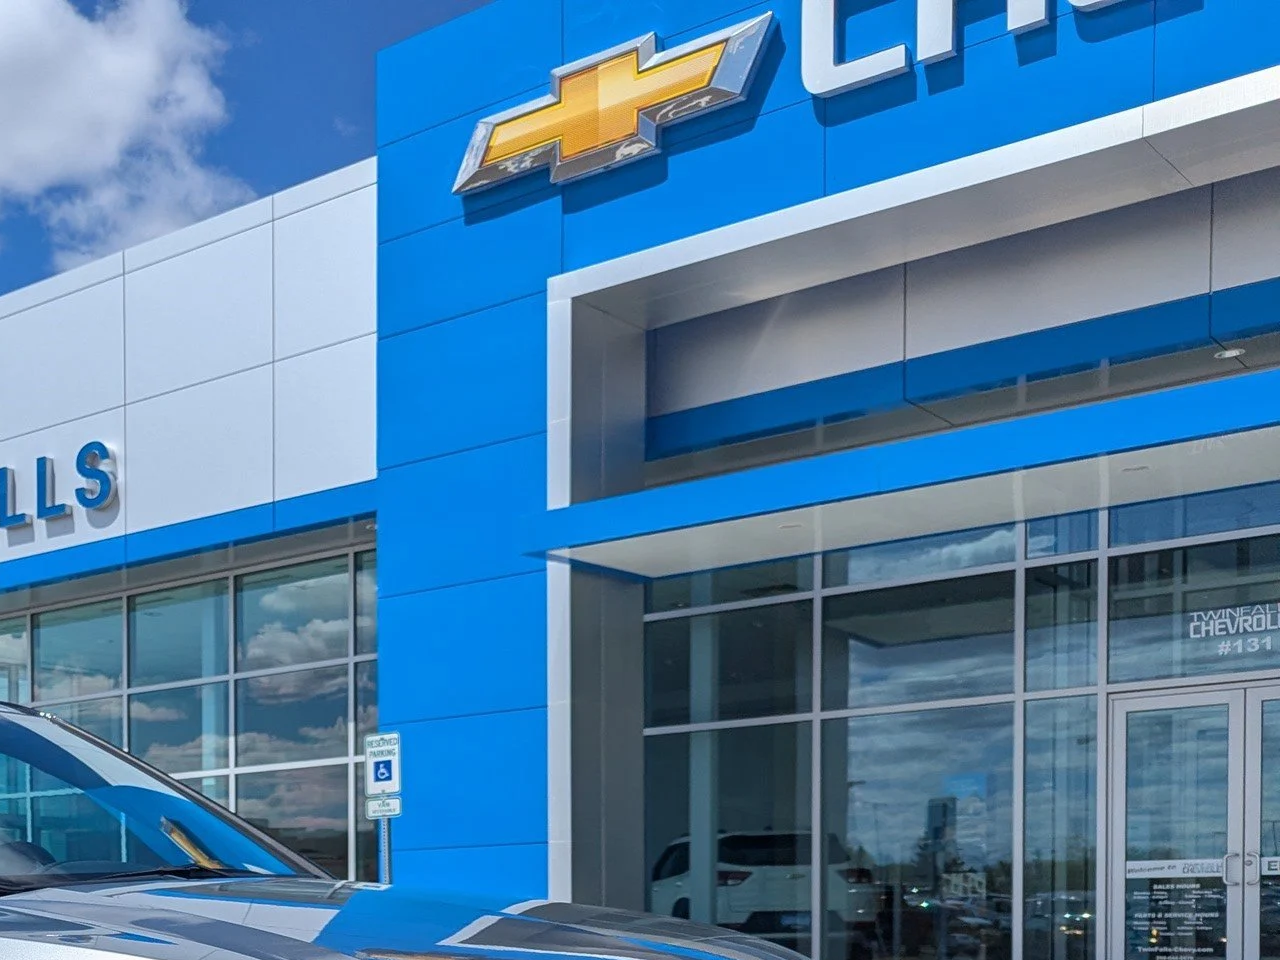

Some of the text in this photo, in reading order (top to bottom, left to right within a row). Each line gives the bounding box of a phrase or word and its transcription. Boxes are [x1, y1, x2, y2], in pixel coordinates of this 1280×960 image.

[1190, 603, 1280, 622] TWINFAL
[1190, 613, 1280, 638] CHEVROL
[1218, 636, 1271, 655] #131
[367, 738, 398, 748] RESERVED
[369, 748, 396, 757] PARKING
